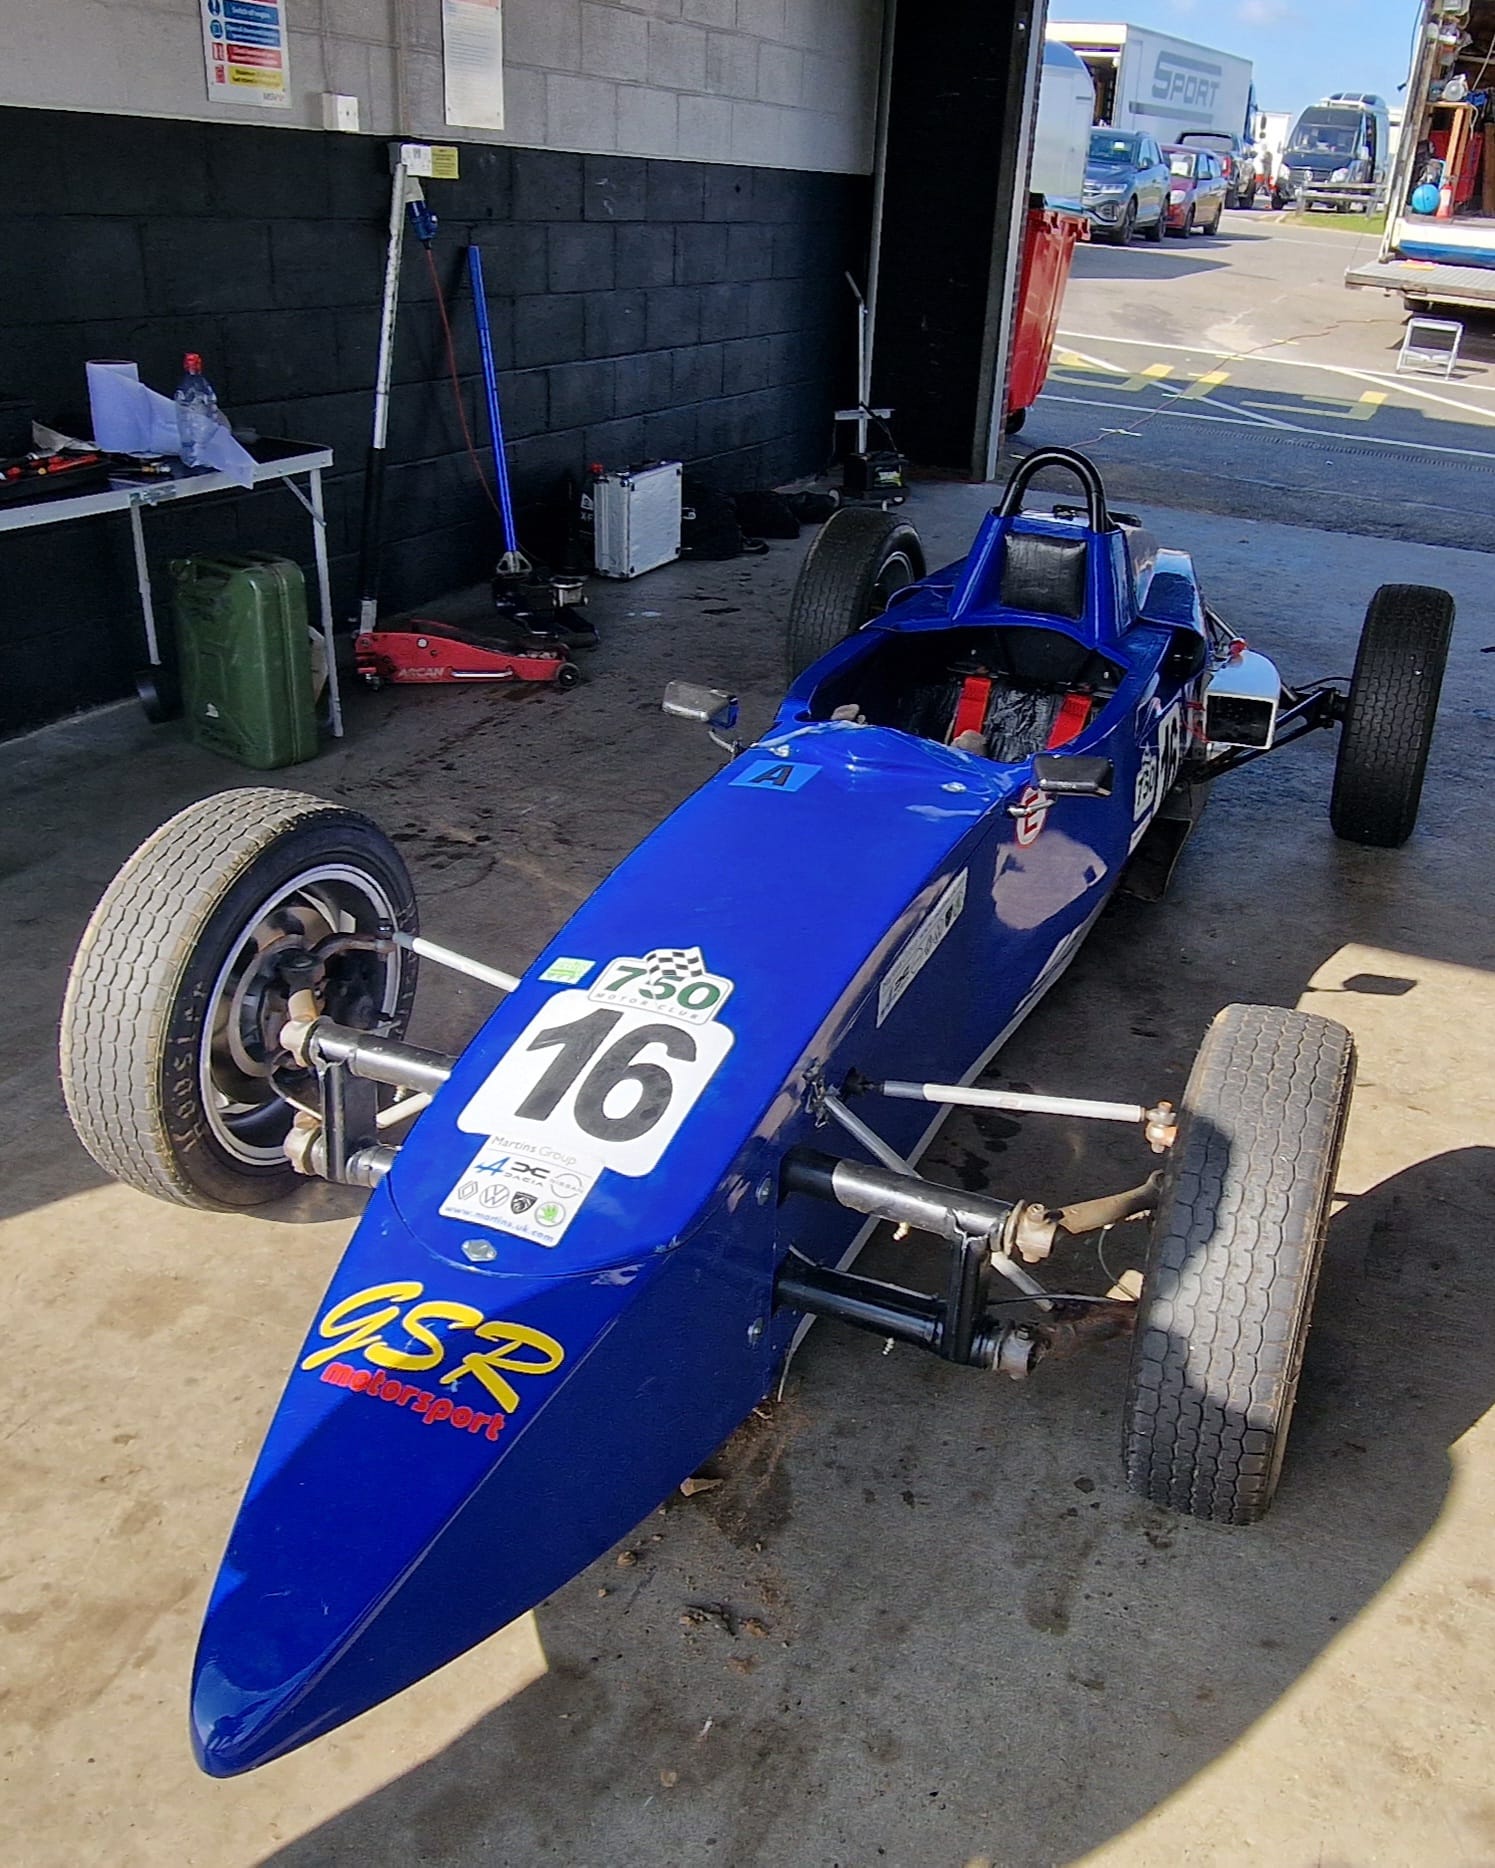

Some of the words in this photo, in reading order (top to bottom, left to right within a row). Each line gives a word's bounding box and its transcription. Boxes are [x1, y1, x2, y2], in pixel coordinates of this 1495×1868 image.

[1152, 51, 1222, 108] SPORT
[399, 667, 444, 677] ARCAN
[748, 764, 794, 786] A
[595, 992, 649, 1006] MOTOR
[604, 965, 721, 1011] 750
[514, 1008, 697, 1142] 16
[492, 1136, 537, 1153] Martins
[539, 1146, 577, 1166] Group
[503, 1172, 544, 1187] DACIA
[445, 1206, 554, 1243] www.martins.uk.com
[301, 1281, 565, 1414] GSR
[320, 1361, 505, 1441] motorsport
